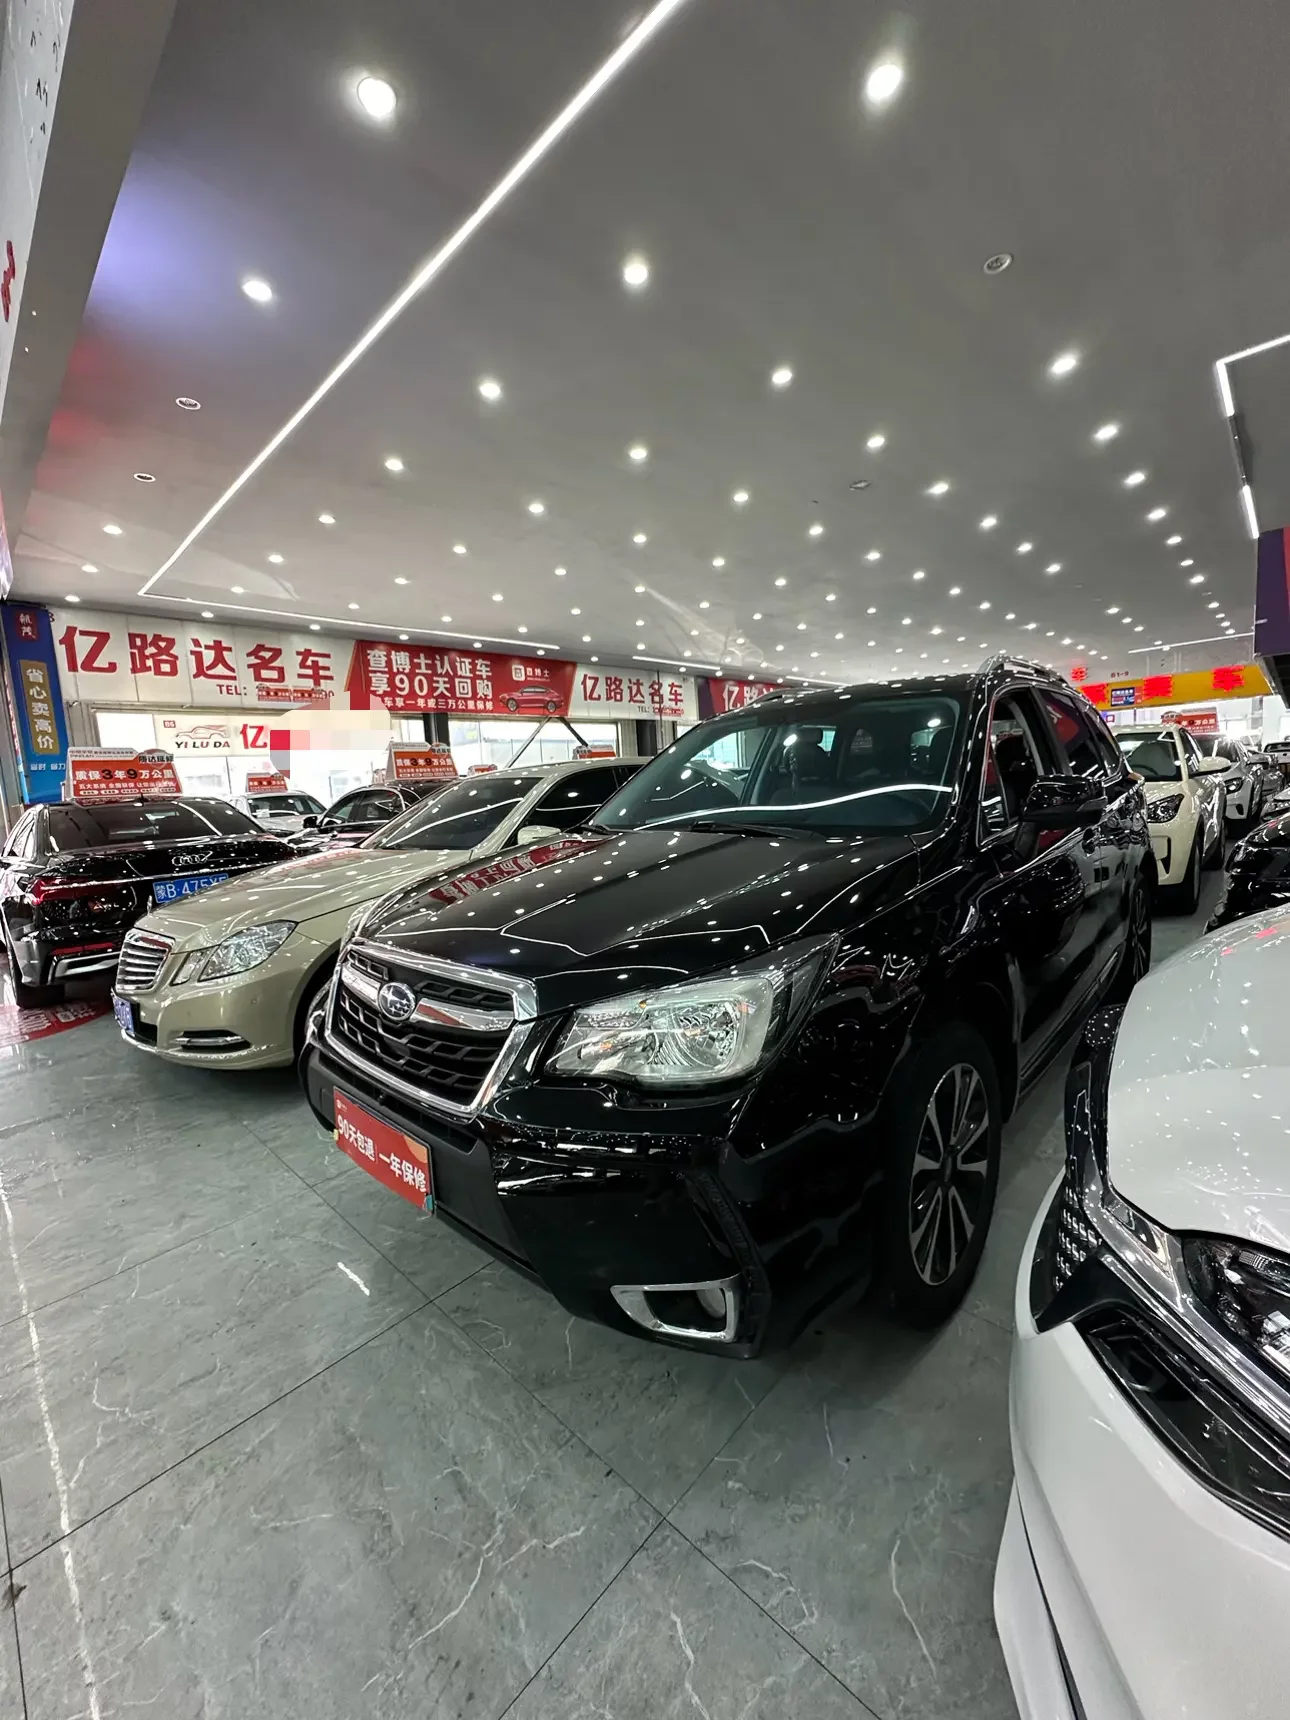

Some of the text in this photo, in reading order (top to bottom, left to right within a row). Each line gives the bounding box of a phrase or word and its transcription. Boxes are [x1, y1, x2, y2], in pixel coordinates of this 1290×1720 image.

[59, 626, 335, 686] 亿路达名车
[367, 649, 492, 679] 查博士认证车
[216, 684, 247, 696] TEL:
[369, 672, 493, 699] 享90天回购
[581, 674, 684, 706] 亿路达名车
[722, 684, 774, 711] 亿路
[26, 668, 54, 750] 省心卖高价
[175, 741, 231, 749] YI LU DA
[337, 1115, 427, 1193] 90天包退 一年保修
